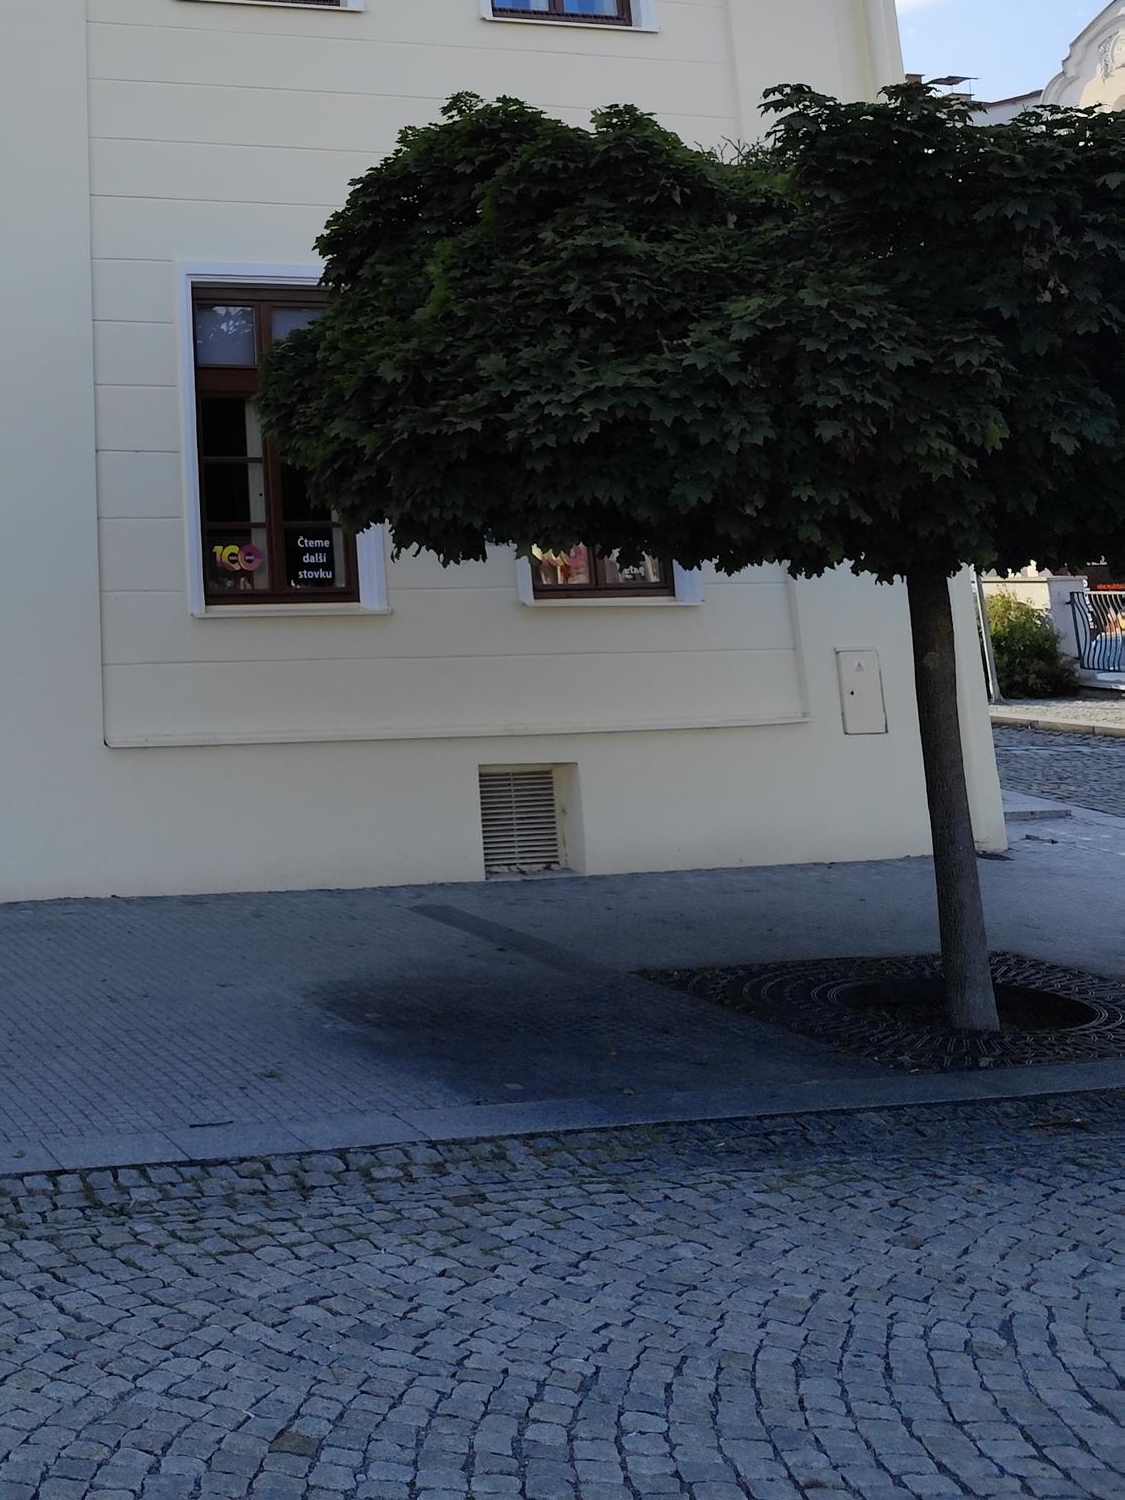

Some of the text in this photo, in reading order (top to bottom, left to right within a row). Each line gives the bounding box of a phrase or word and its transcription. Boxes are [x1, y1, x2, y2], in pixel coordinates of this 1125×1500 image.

[297, 535, 330, 548] Čteme
[302, 552, 327, 564] další
[298, 568, 333, 580] stovku
